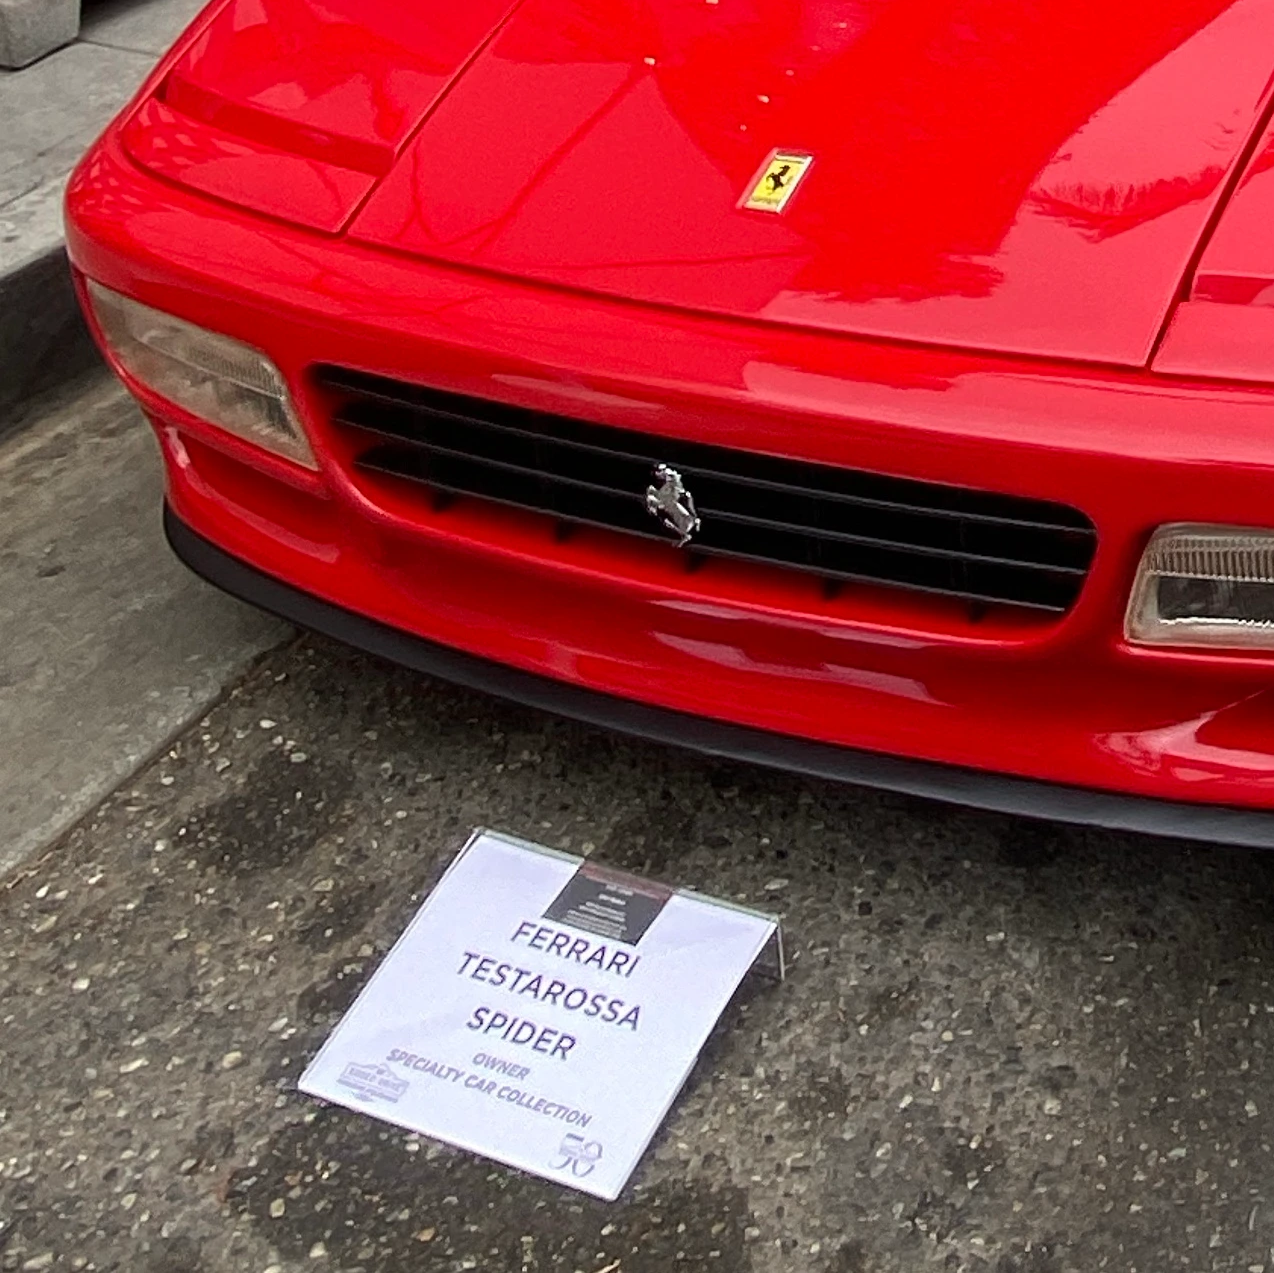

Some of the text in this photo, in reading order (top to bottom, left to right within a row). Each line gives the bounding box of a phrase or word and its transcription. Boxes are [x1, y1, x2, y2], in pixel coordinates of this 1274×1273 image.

[510, 921, 641, 977] FERRARI
[457, 952, 641, 1031] TESTAROSSA
[466, 1006, 576, 1061] SPIDER
[386, 1048, 464, 1083] SPECIALTY
[464, 1074, 498, 1095] CAR
[497, 1086, 593, 1128] COLLECTION
[472, 1052, 531, 1081] OWNER
